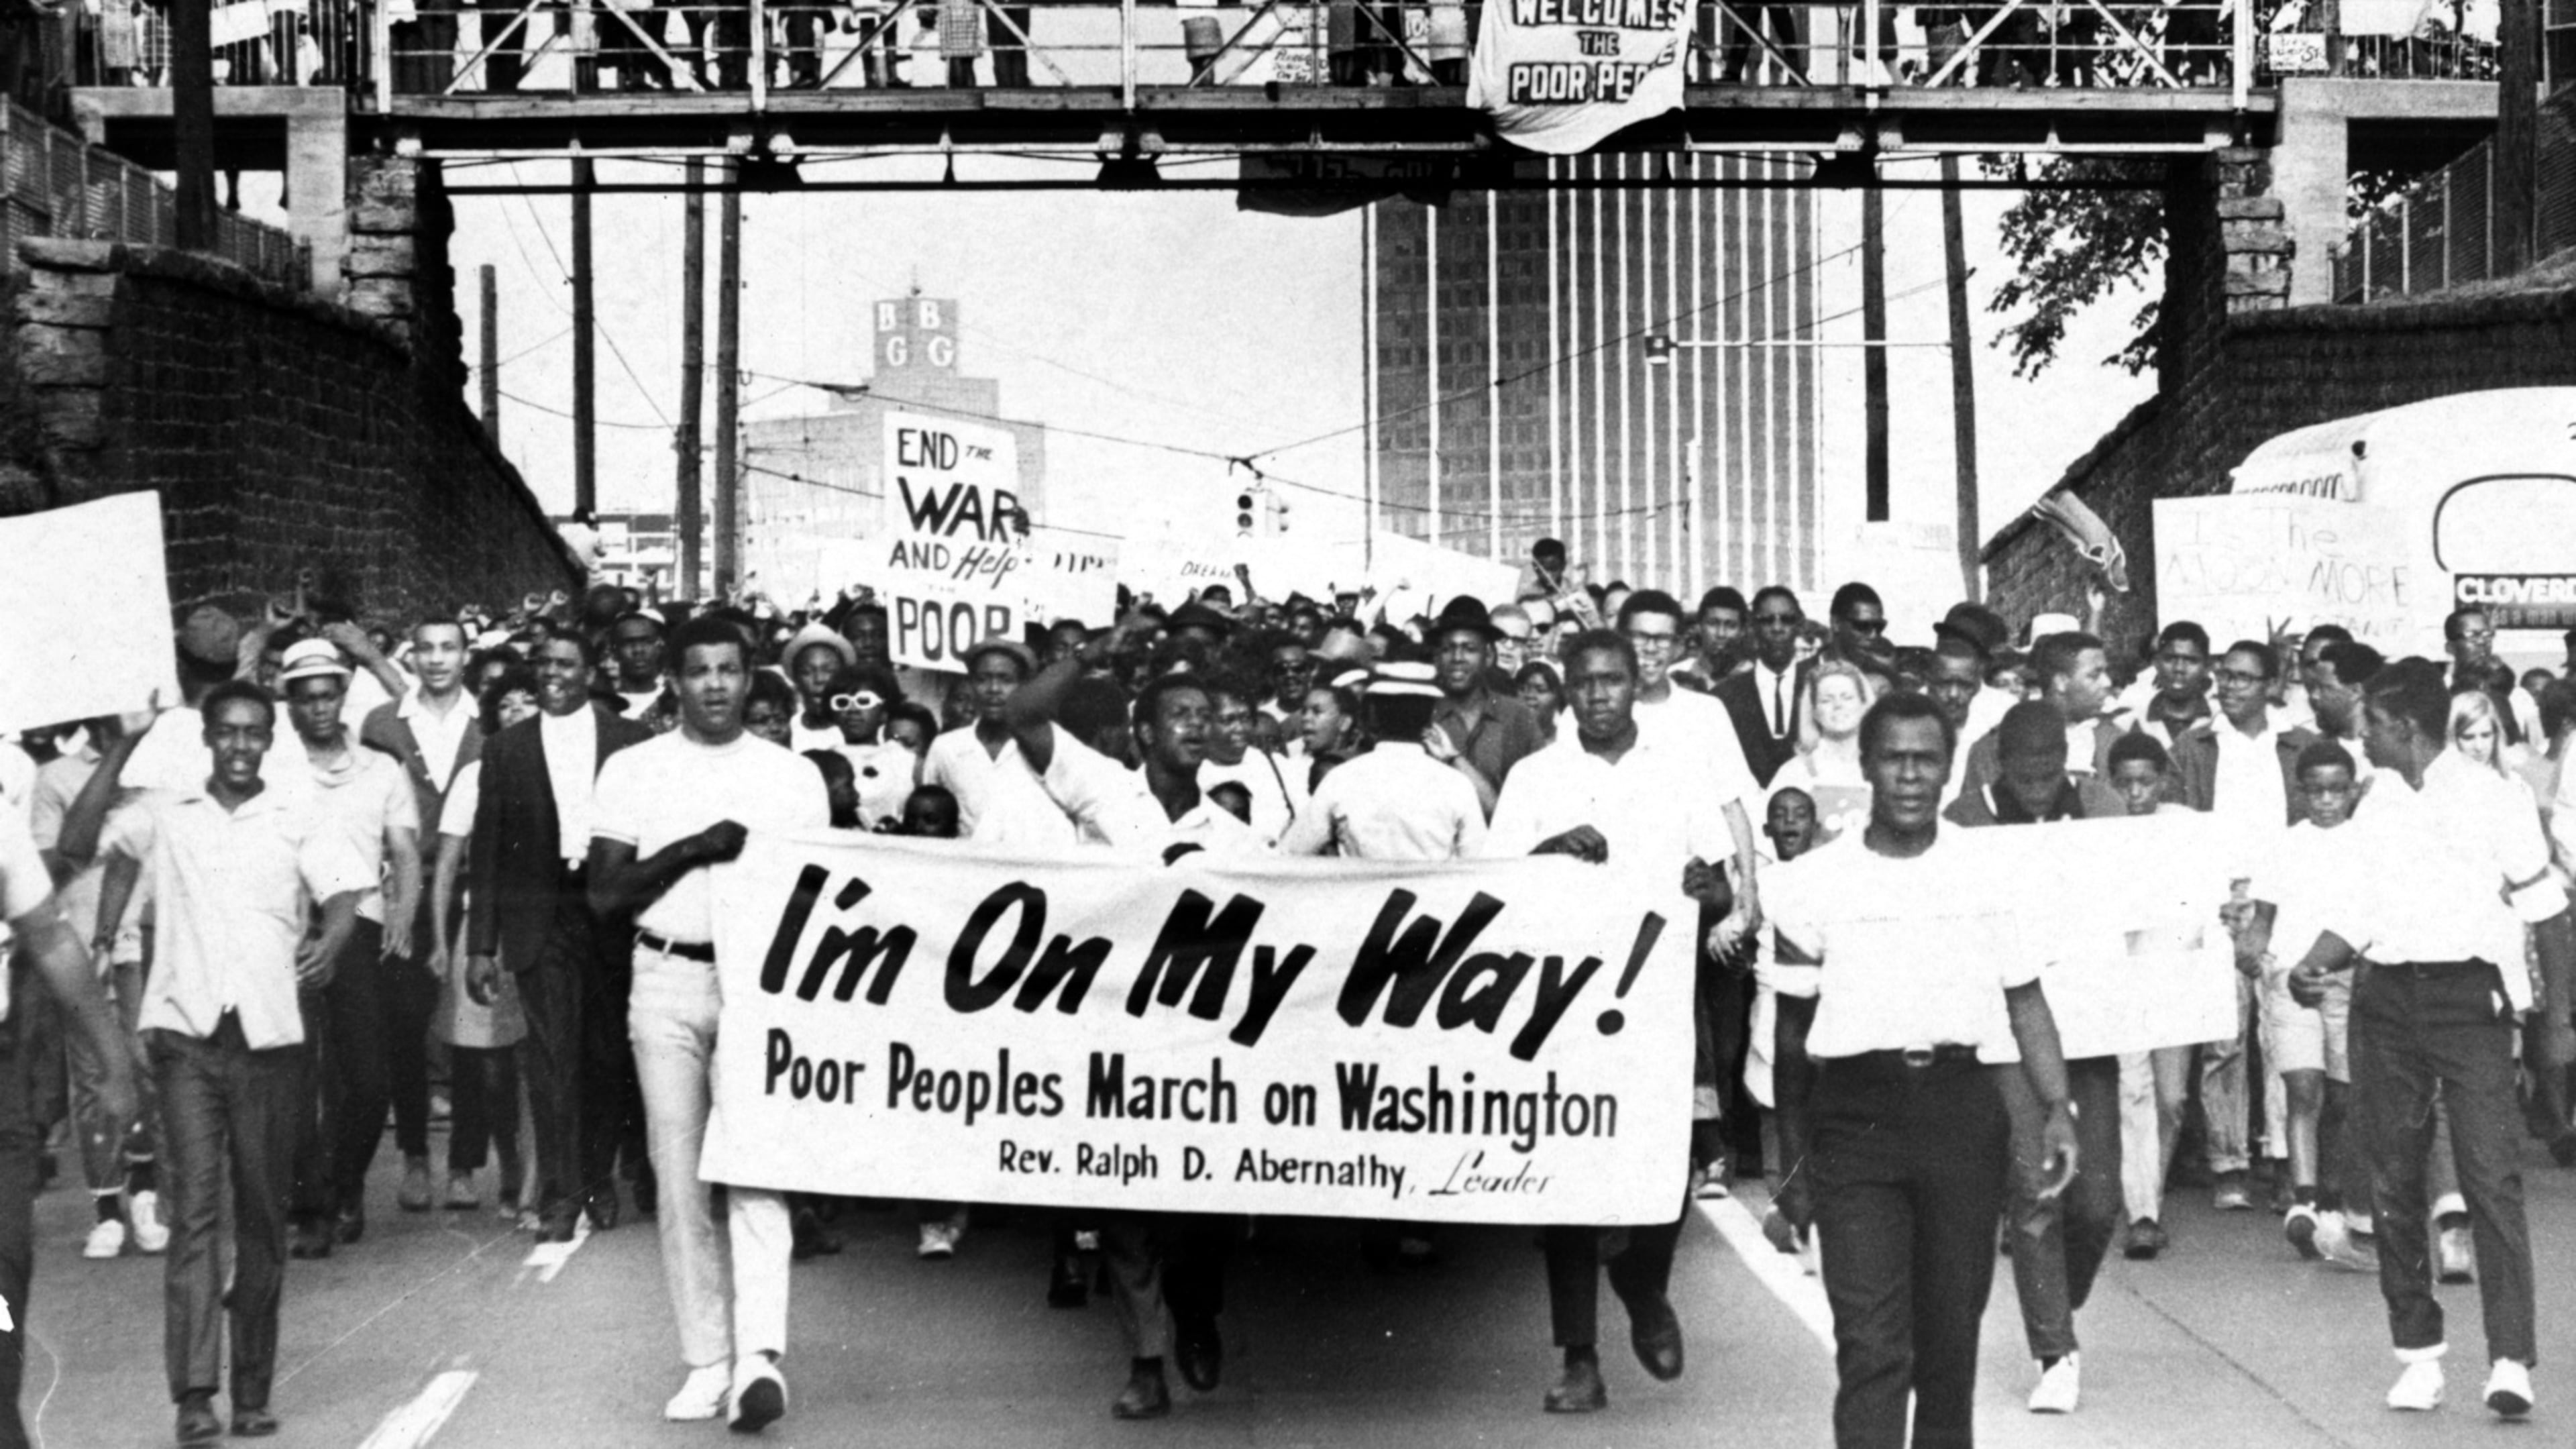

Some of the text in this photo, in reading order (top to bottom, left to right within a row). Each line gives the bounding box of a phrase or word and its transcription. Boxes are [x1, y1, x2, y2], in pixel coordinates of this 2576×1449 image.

[1513, 0, 1677, 30] WELCOMES
[1578, 32, 1619, 56] THE
[1511, 62, 1589, 103] POOR
[898, 428, 994, 470] END THE
[896, 476, 1018, 545] WAR
[888, 539, 951, 571] AND
[951, 545, 1019, 590] Help
[2308, 559, 2410, 608] MORE
[760, 863, 1666, 1062] I'm On My Way!
[765, 1028, 1617, 1153] Poor Peoples March on Washington
[1000, 1140, 1555, 1201] Rev. Ralph D. Abernathy, Leader
